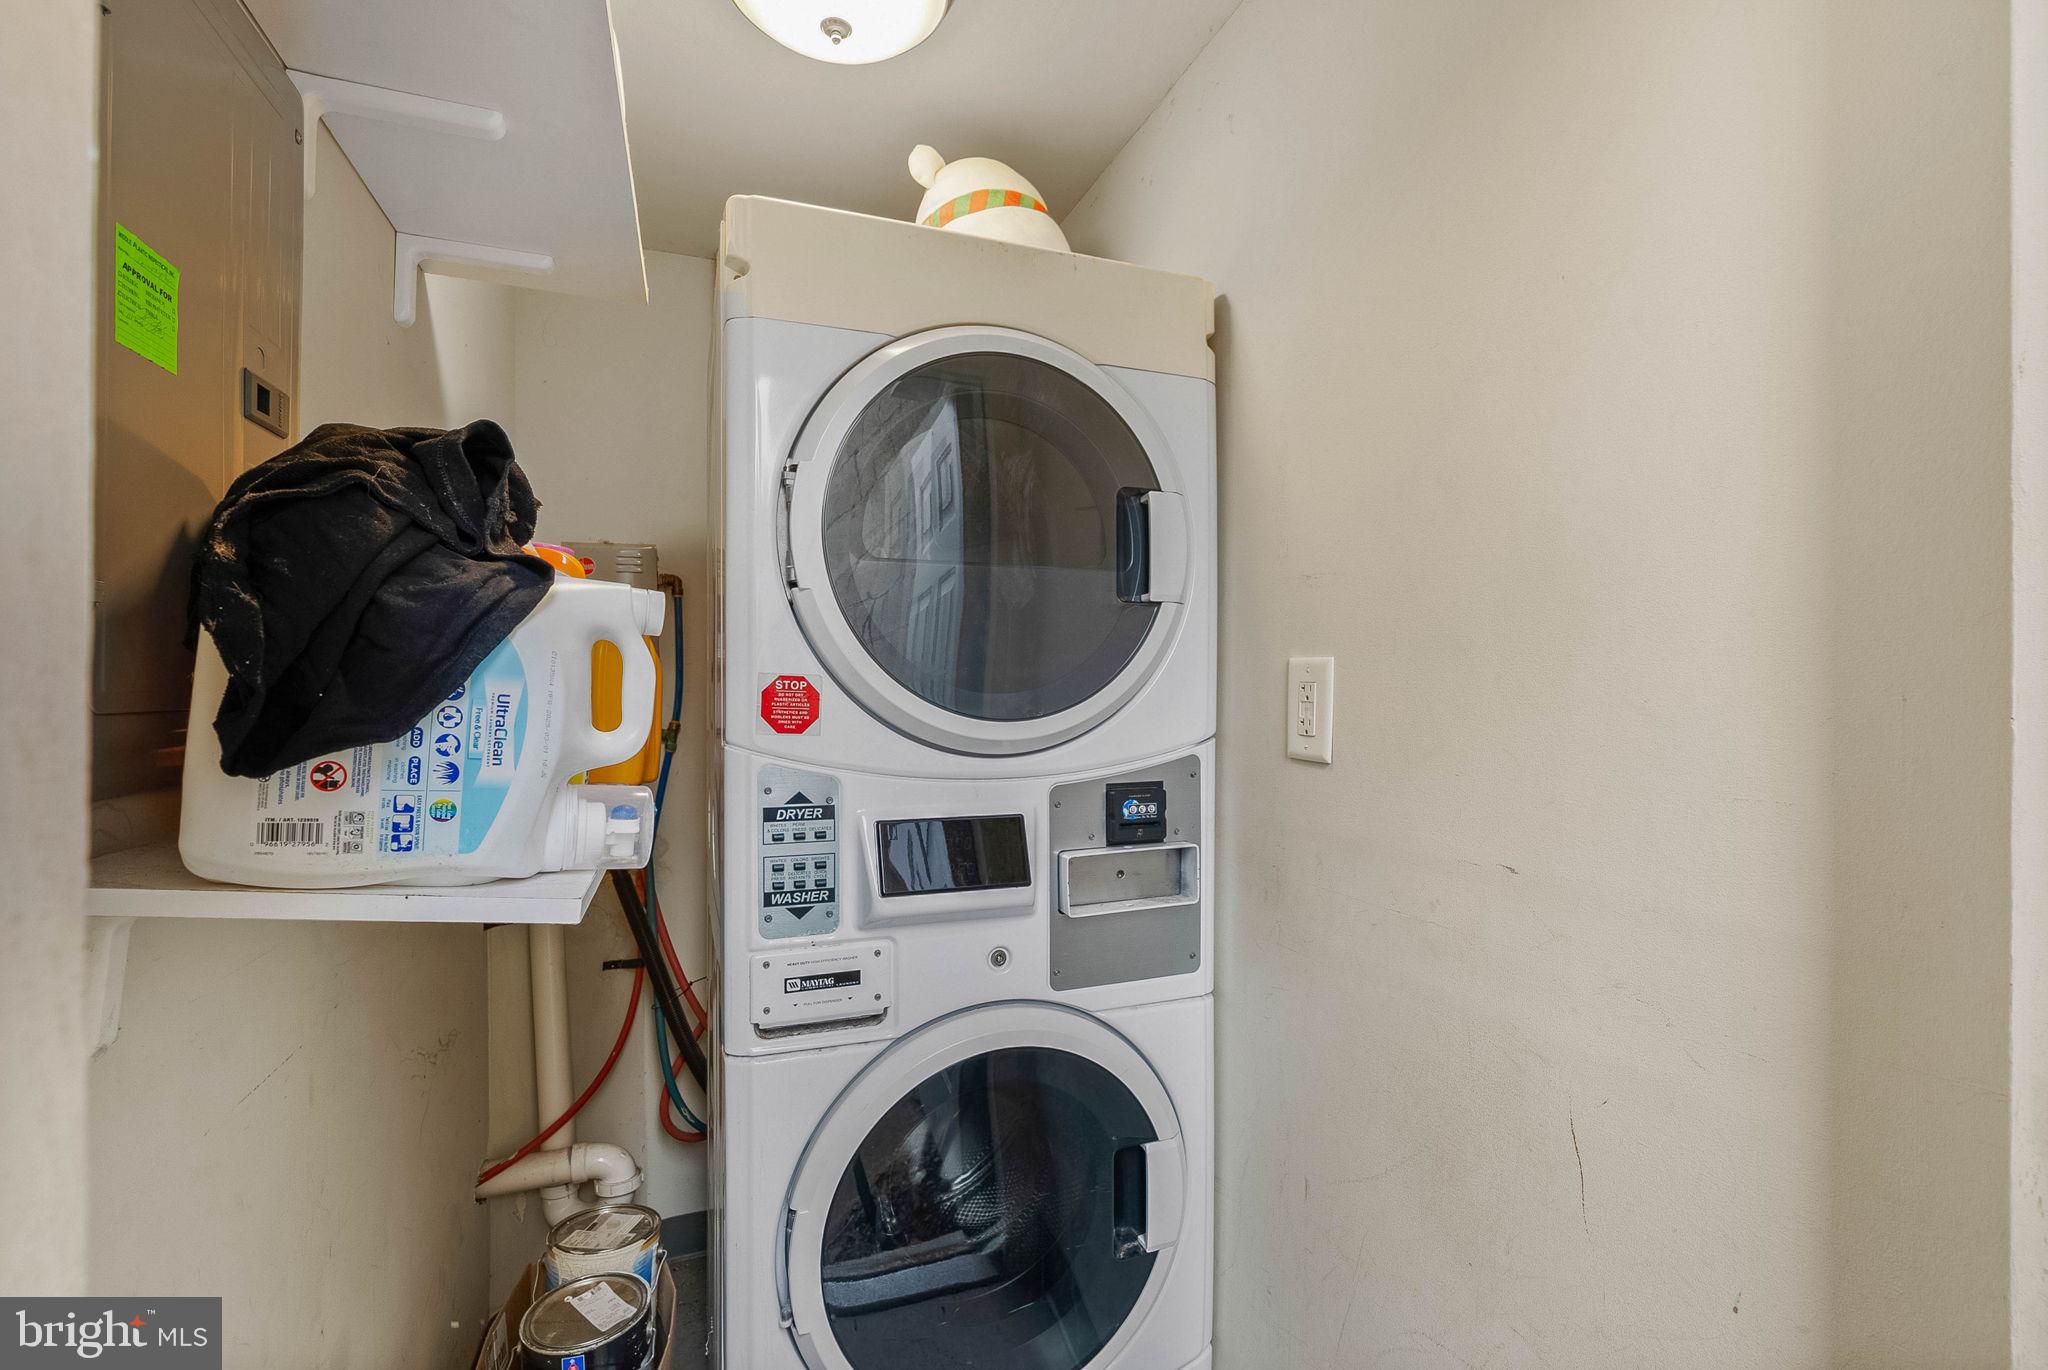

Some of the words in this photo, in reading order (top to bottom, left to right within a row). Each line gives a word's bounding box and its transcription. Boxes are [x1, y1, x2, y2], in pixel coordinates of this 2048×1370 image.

[123, 262, 159, 293] APPROVAL
[160, 288, 172, 303] FOR
[776, 680, 807, 690] STOP
[475, 708, 483, 723] Free
[492, 694, 511, 766] UltraClean
[473, 732, 481, 750] Clear
[410, 758, 418, 783] PLACE
[776, 808, 822, 820] DRYER
[771, 890, 829, 905] WASHER
[802, 977, 834, 988] MAYTAG
